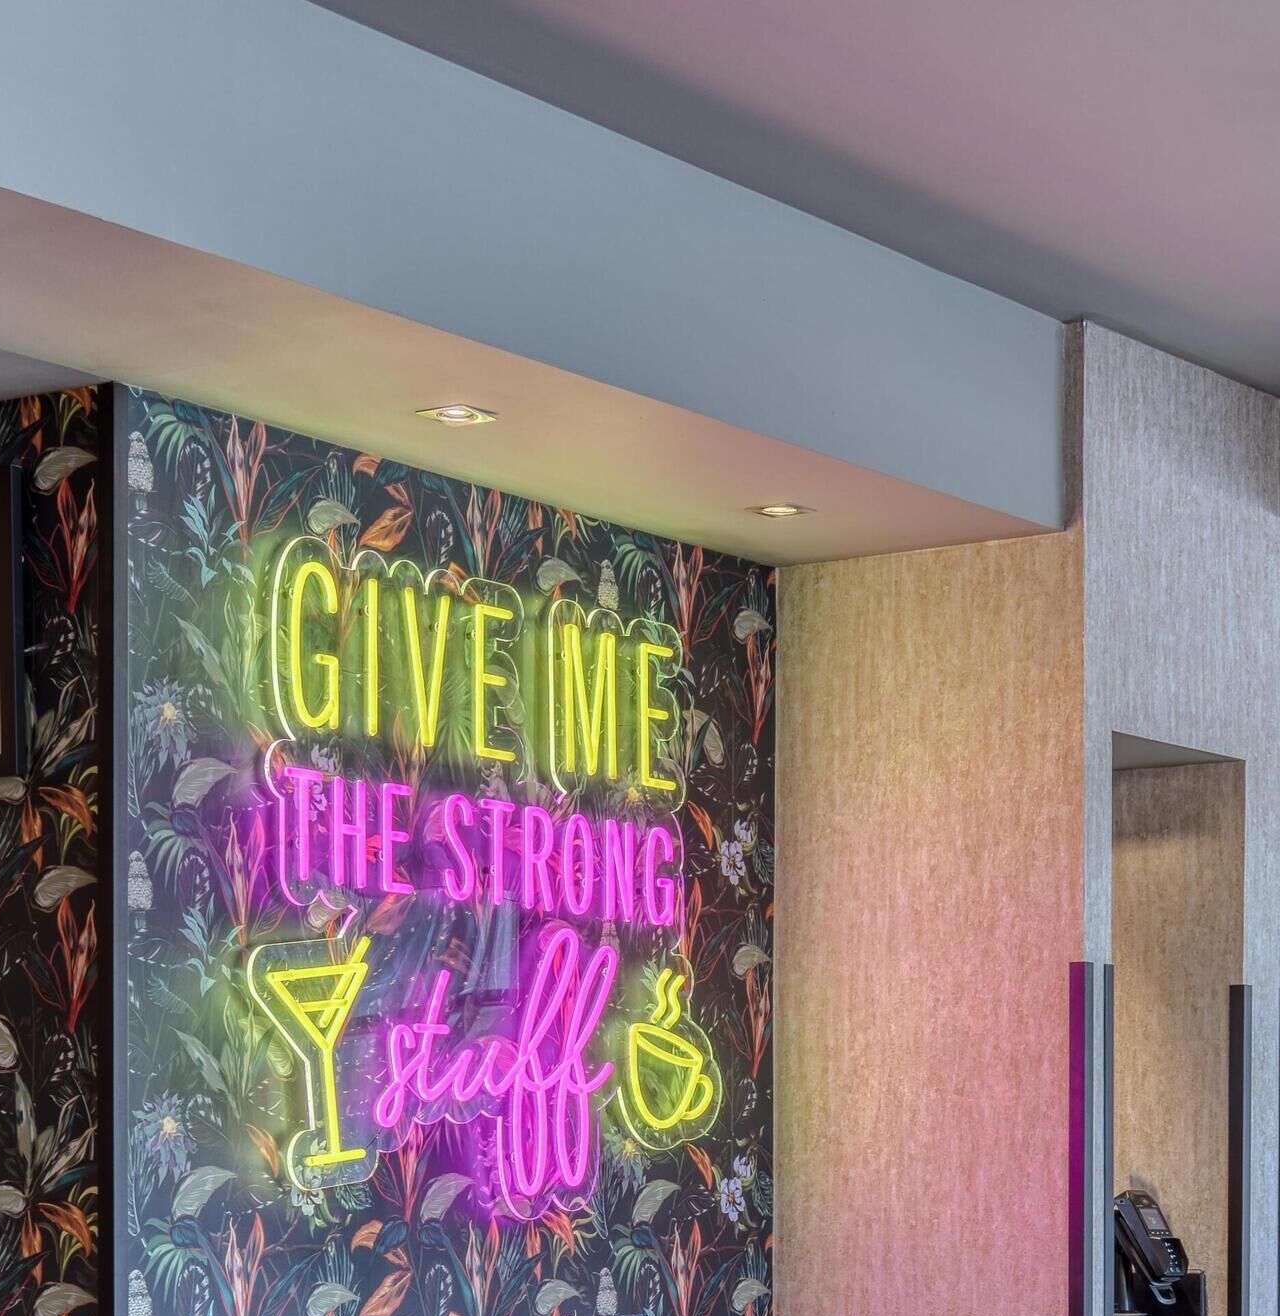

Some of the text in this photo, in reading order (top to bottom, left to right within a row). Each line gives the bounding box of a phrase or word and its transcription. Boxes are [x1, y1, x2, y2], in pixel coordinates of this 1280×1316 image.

[286, 559, 678, 792] GIVE ME
[284, 765, 676, 927] THE STRONG
[374, 926, 616, 1197] stuff
